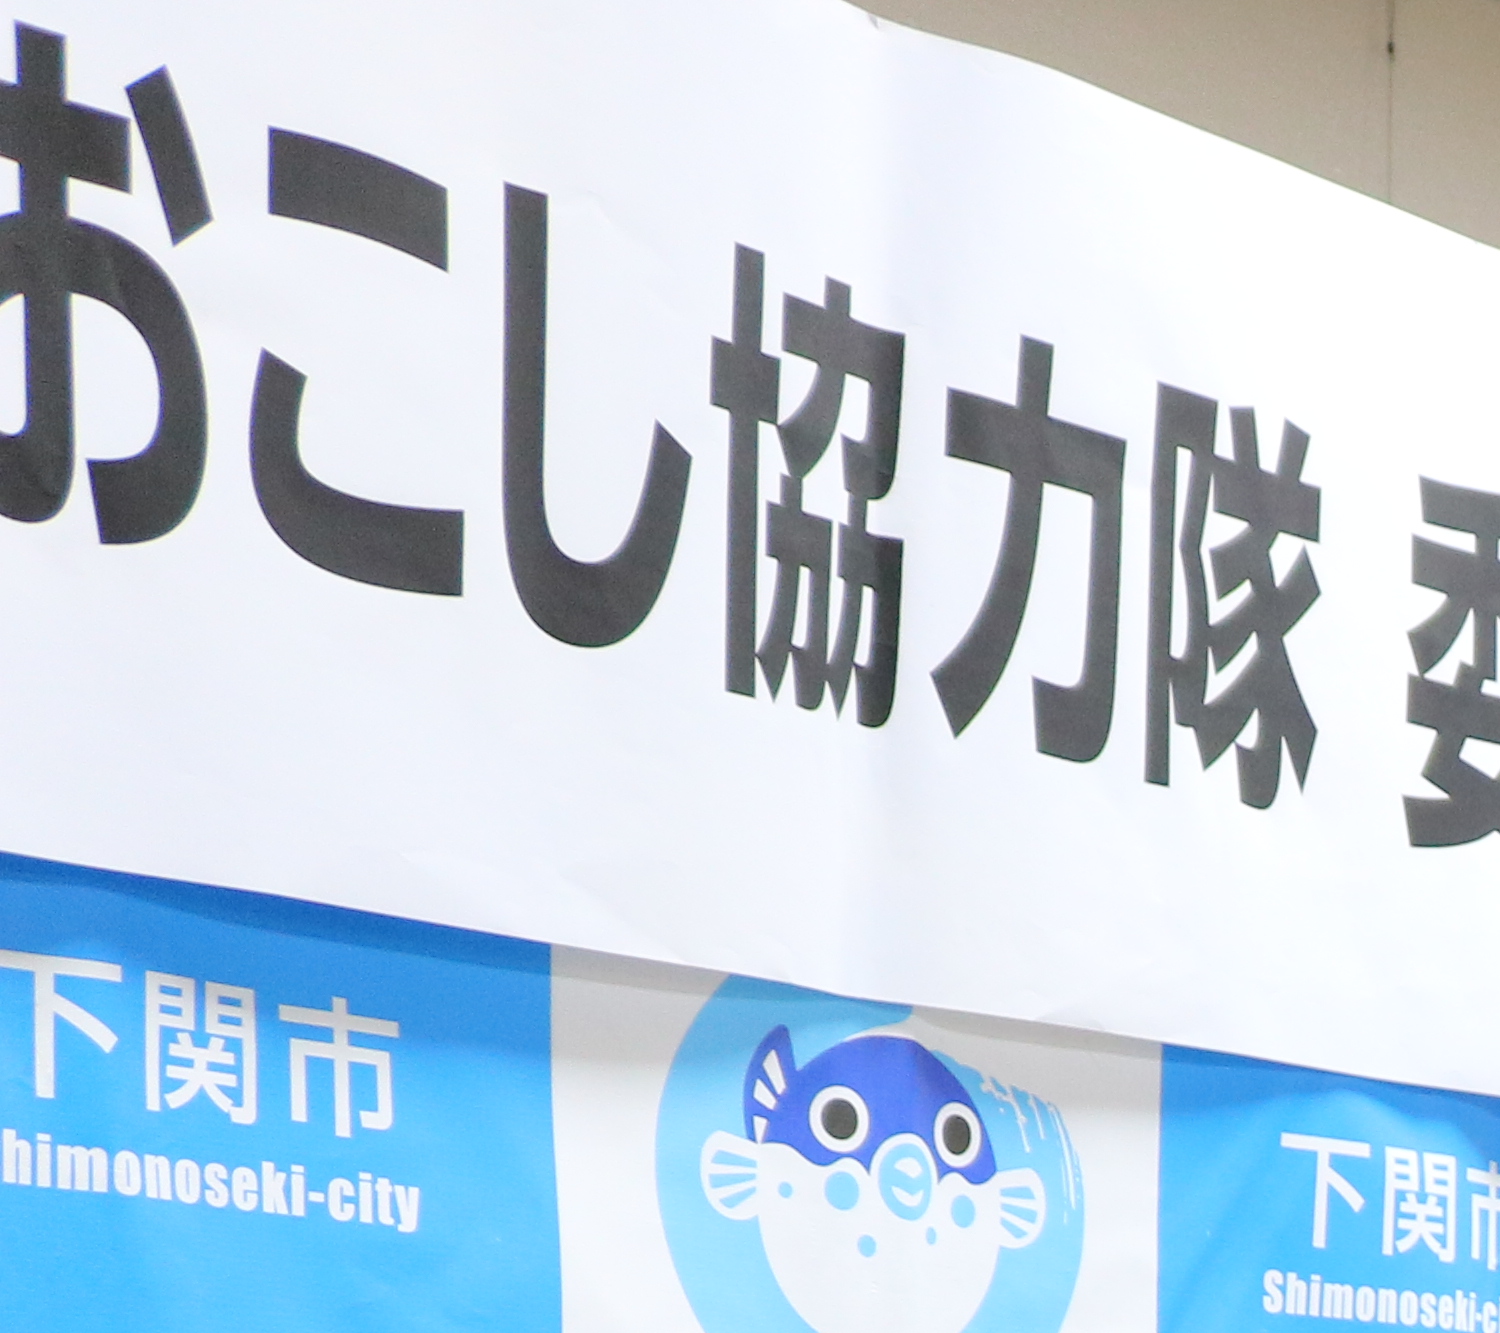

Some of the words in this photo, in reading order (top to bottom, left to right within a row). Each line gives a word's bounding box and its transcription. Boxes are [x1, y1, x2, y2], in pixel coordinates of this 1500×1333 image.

[0, 20, 1322, 810] おこし協力隊
[0, 949, 400, 1138] 下関市
[2, 1128, 420, 1233] himonoseki-city
